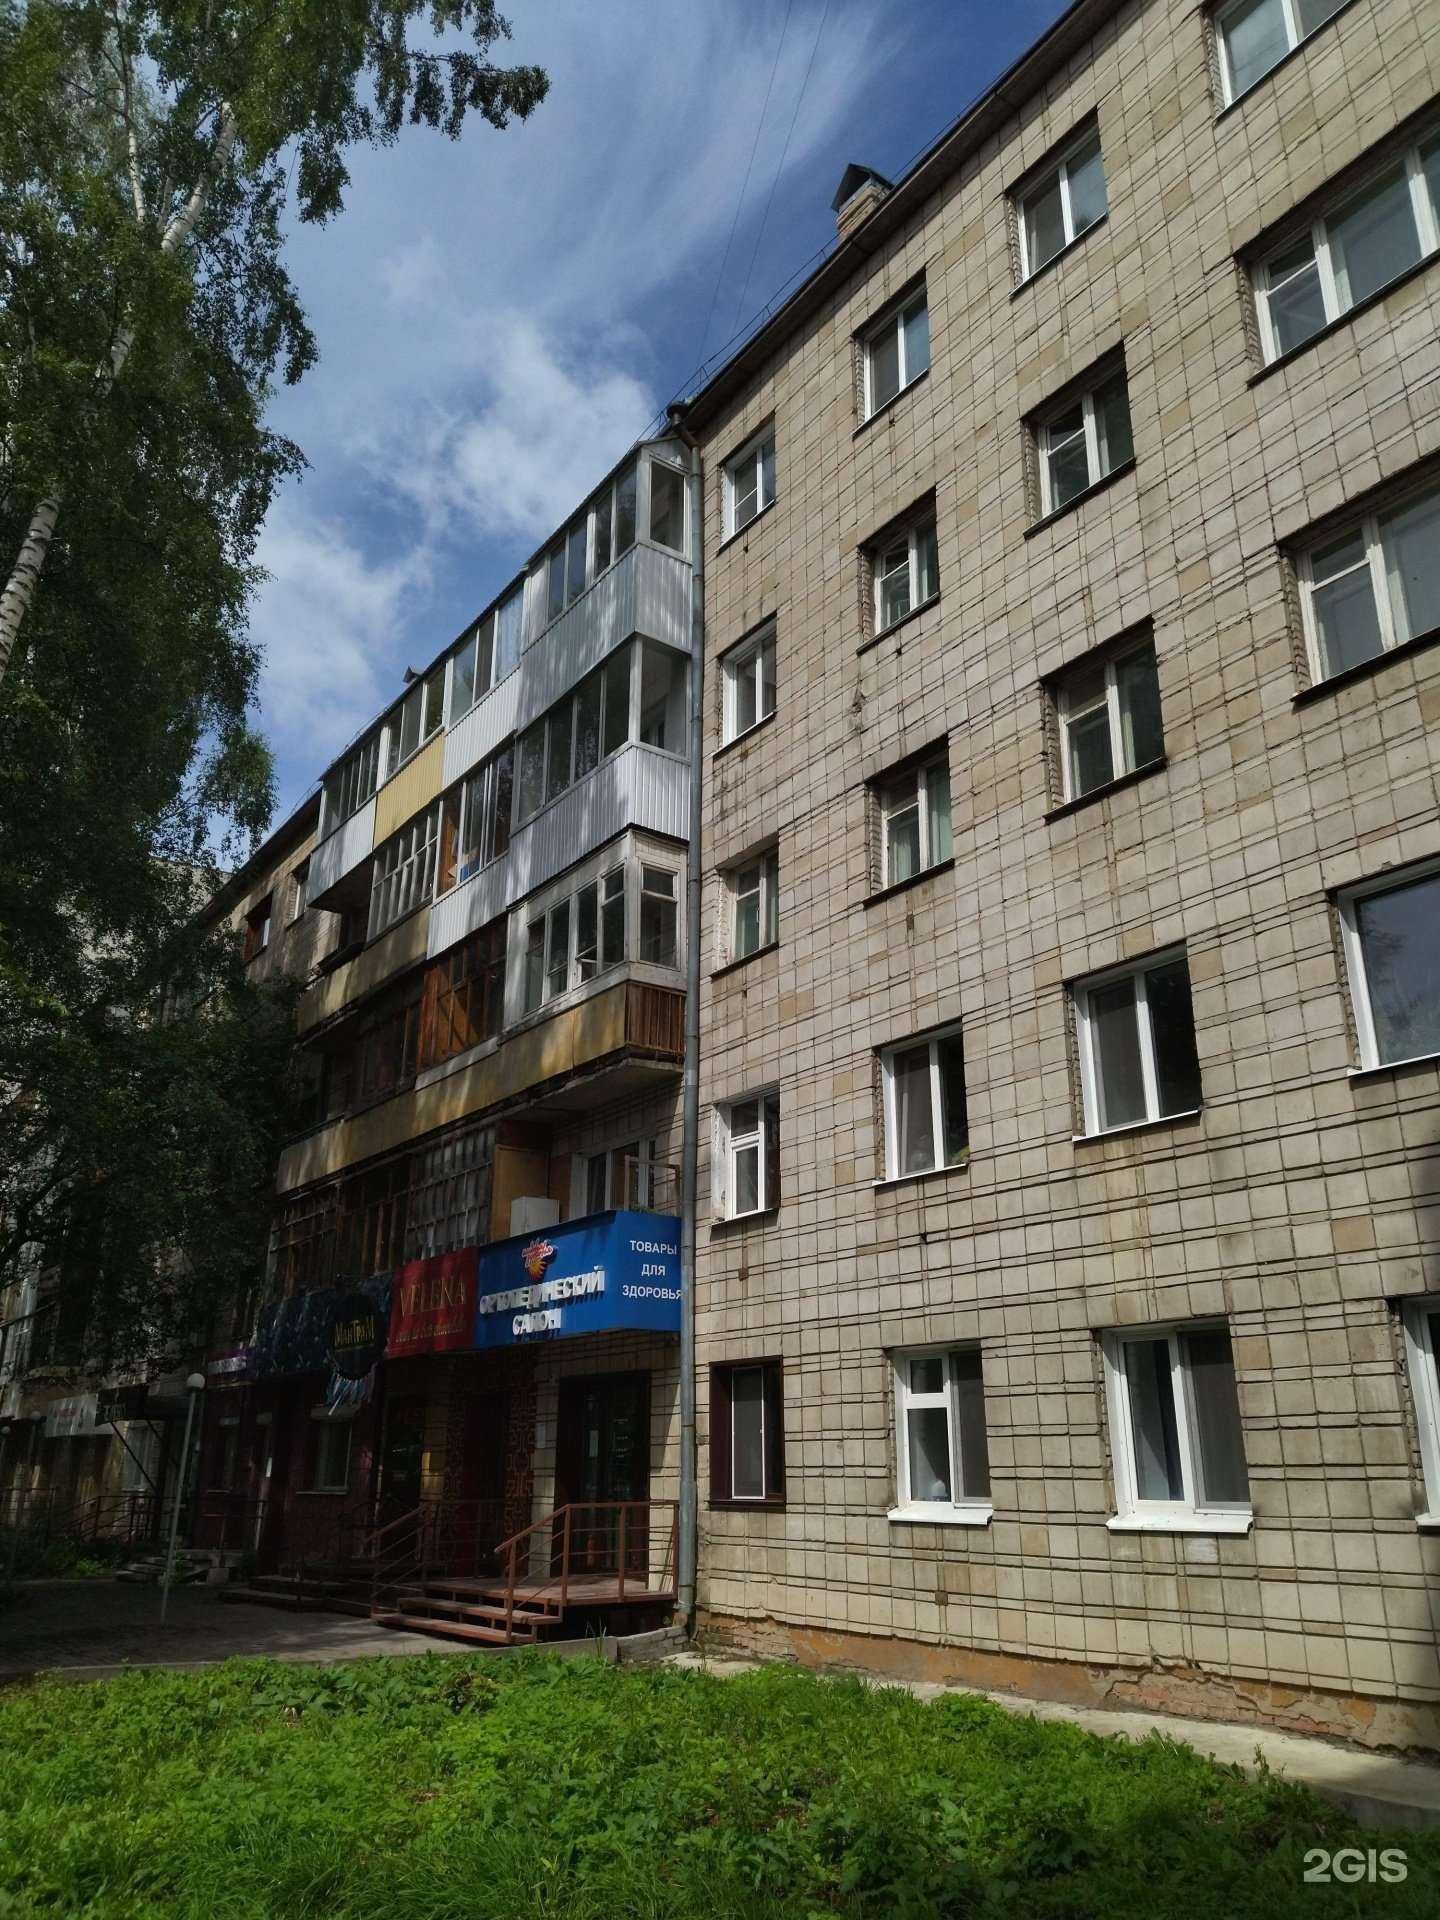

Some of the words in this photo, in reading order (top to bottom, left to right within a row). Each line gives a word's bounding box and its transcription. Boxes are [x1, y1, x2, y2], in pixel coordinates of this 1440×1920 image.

[629, 1240, 677, 1255] ТОВАРЫ
[641, 1263, 666, 1277] ДЛЯ
[512, 1307, 562, 1336] САЛОН
